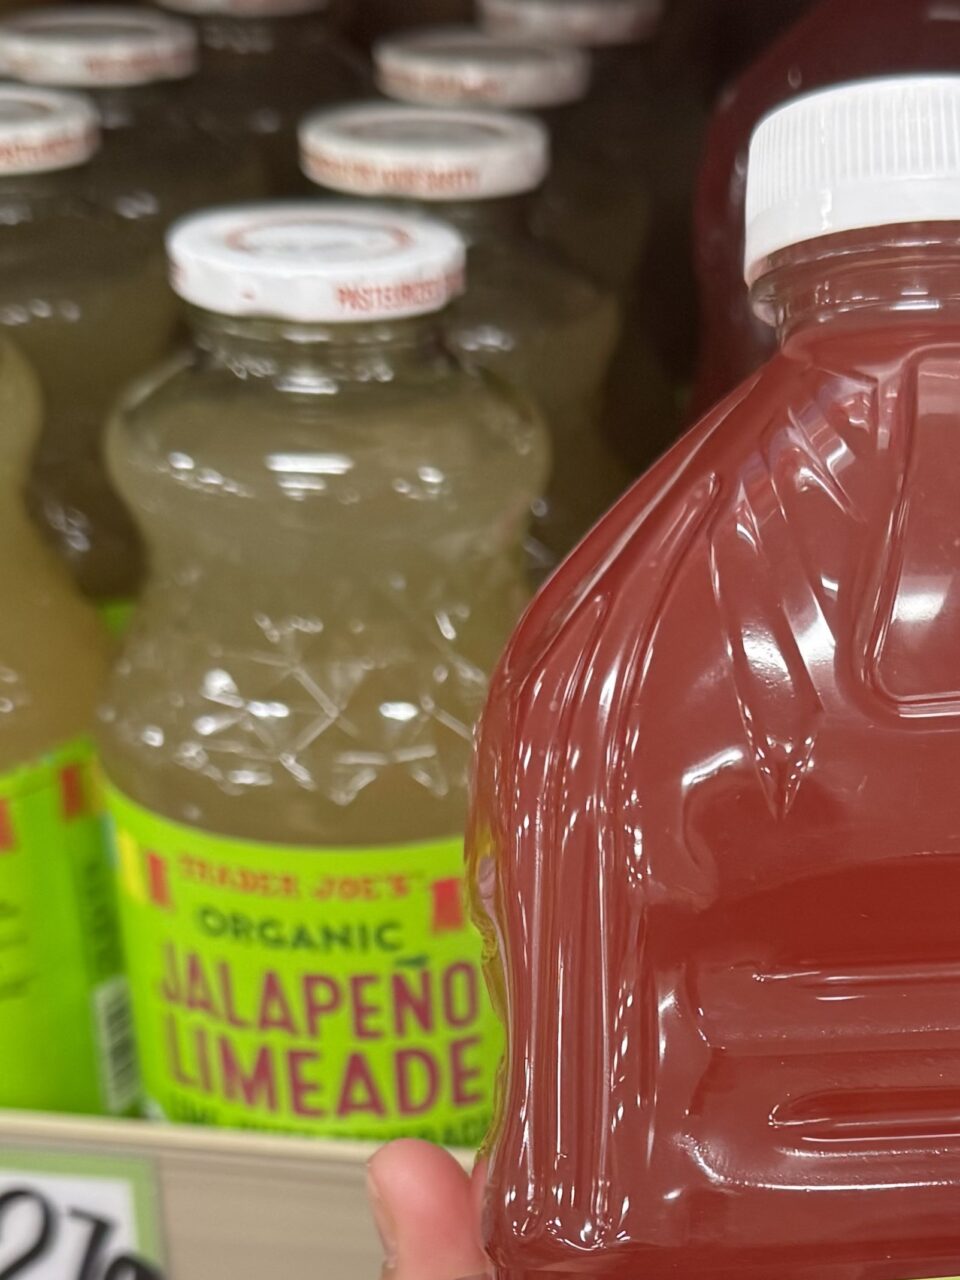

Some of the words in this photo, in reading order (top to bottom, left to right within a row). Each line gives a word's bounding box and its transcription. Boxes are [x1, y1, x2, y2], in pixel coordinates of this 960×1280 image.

[178, 854, 302, 899] TRADER
[200, 905, 405, 952] ORGANIC
[164, 1012, 485, 1120] LIMEADE
